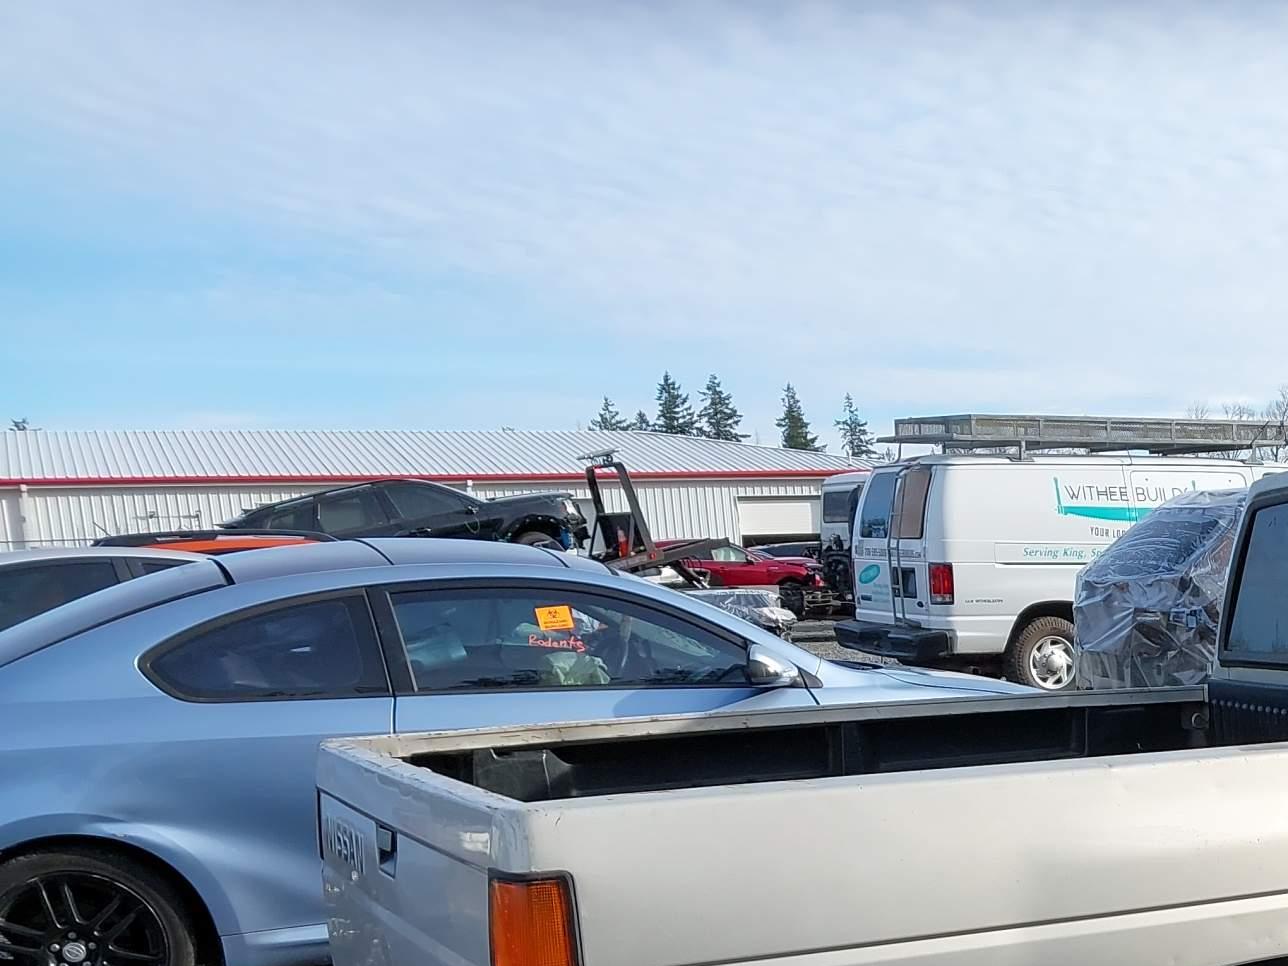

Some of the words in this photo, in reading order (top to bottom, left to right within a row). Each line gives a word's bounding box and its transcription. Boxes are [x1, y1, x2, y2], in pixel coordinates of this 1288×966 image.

[1064, 485, 1129, 502] WITHEE
[1135, 487, 1187, 502] BUILD
[1089, 527, 1110, 537] YOUR
[1023, 547, 1059, 560] Serving
[528, 634, 587, 653] Rodents
[325, 815, 365, 874] NISSAN
